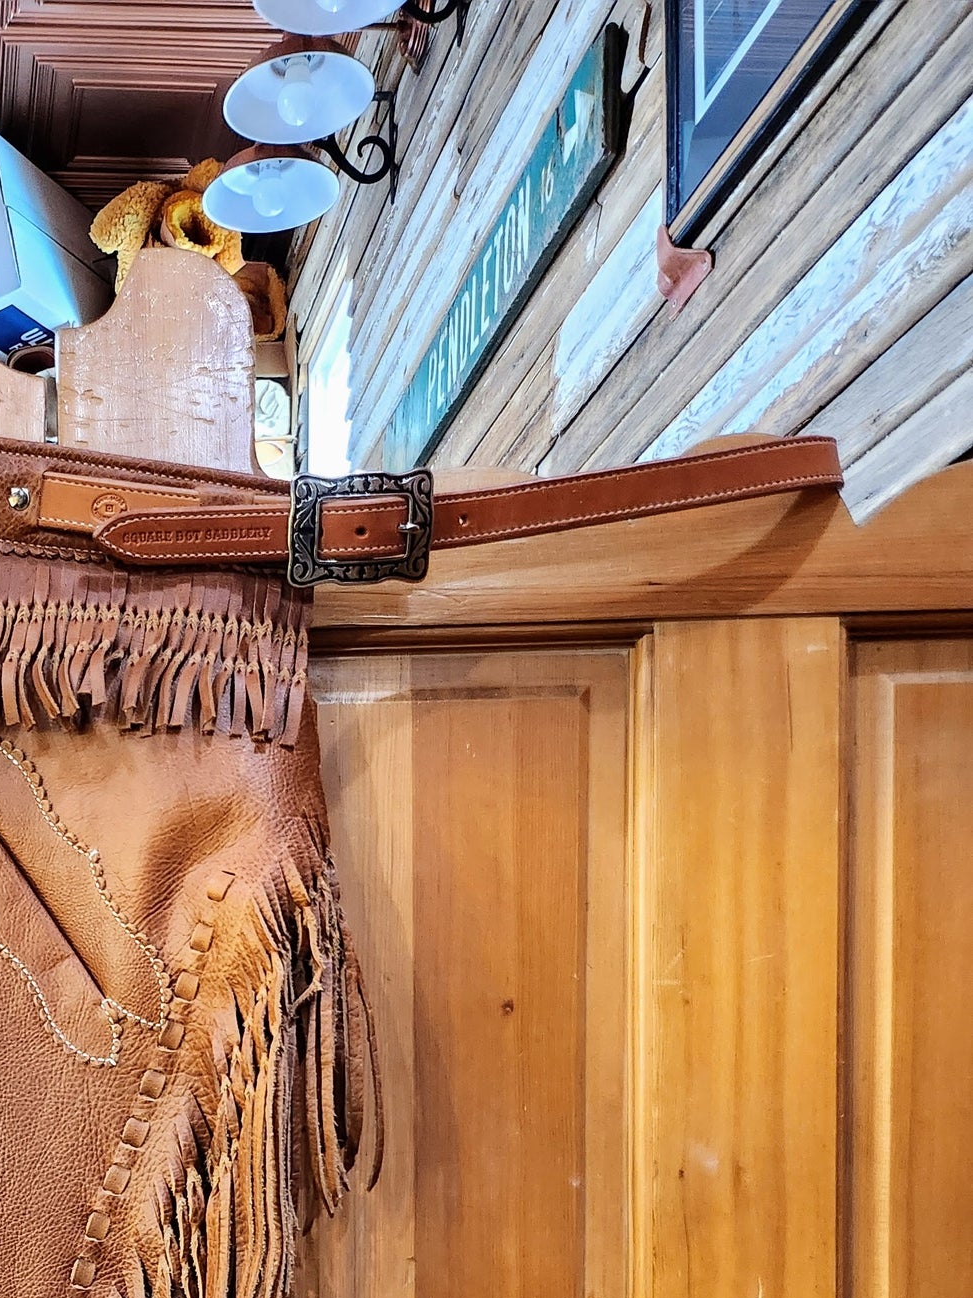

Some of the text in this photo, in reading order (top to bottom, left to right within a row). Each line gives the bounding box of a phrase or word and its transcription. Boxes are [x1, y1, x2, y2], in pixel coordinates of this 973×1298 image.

[426, 175, 531, 425] PENDLETON
[122, 530, 174, 546] SQUARE
[204, 527, 273, 542] SADDLERY
